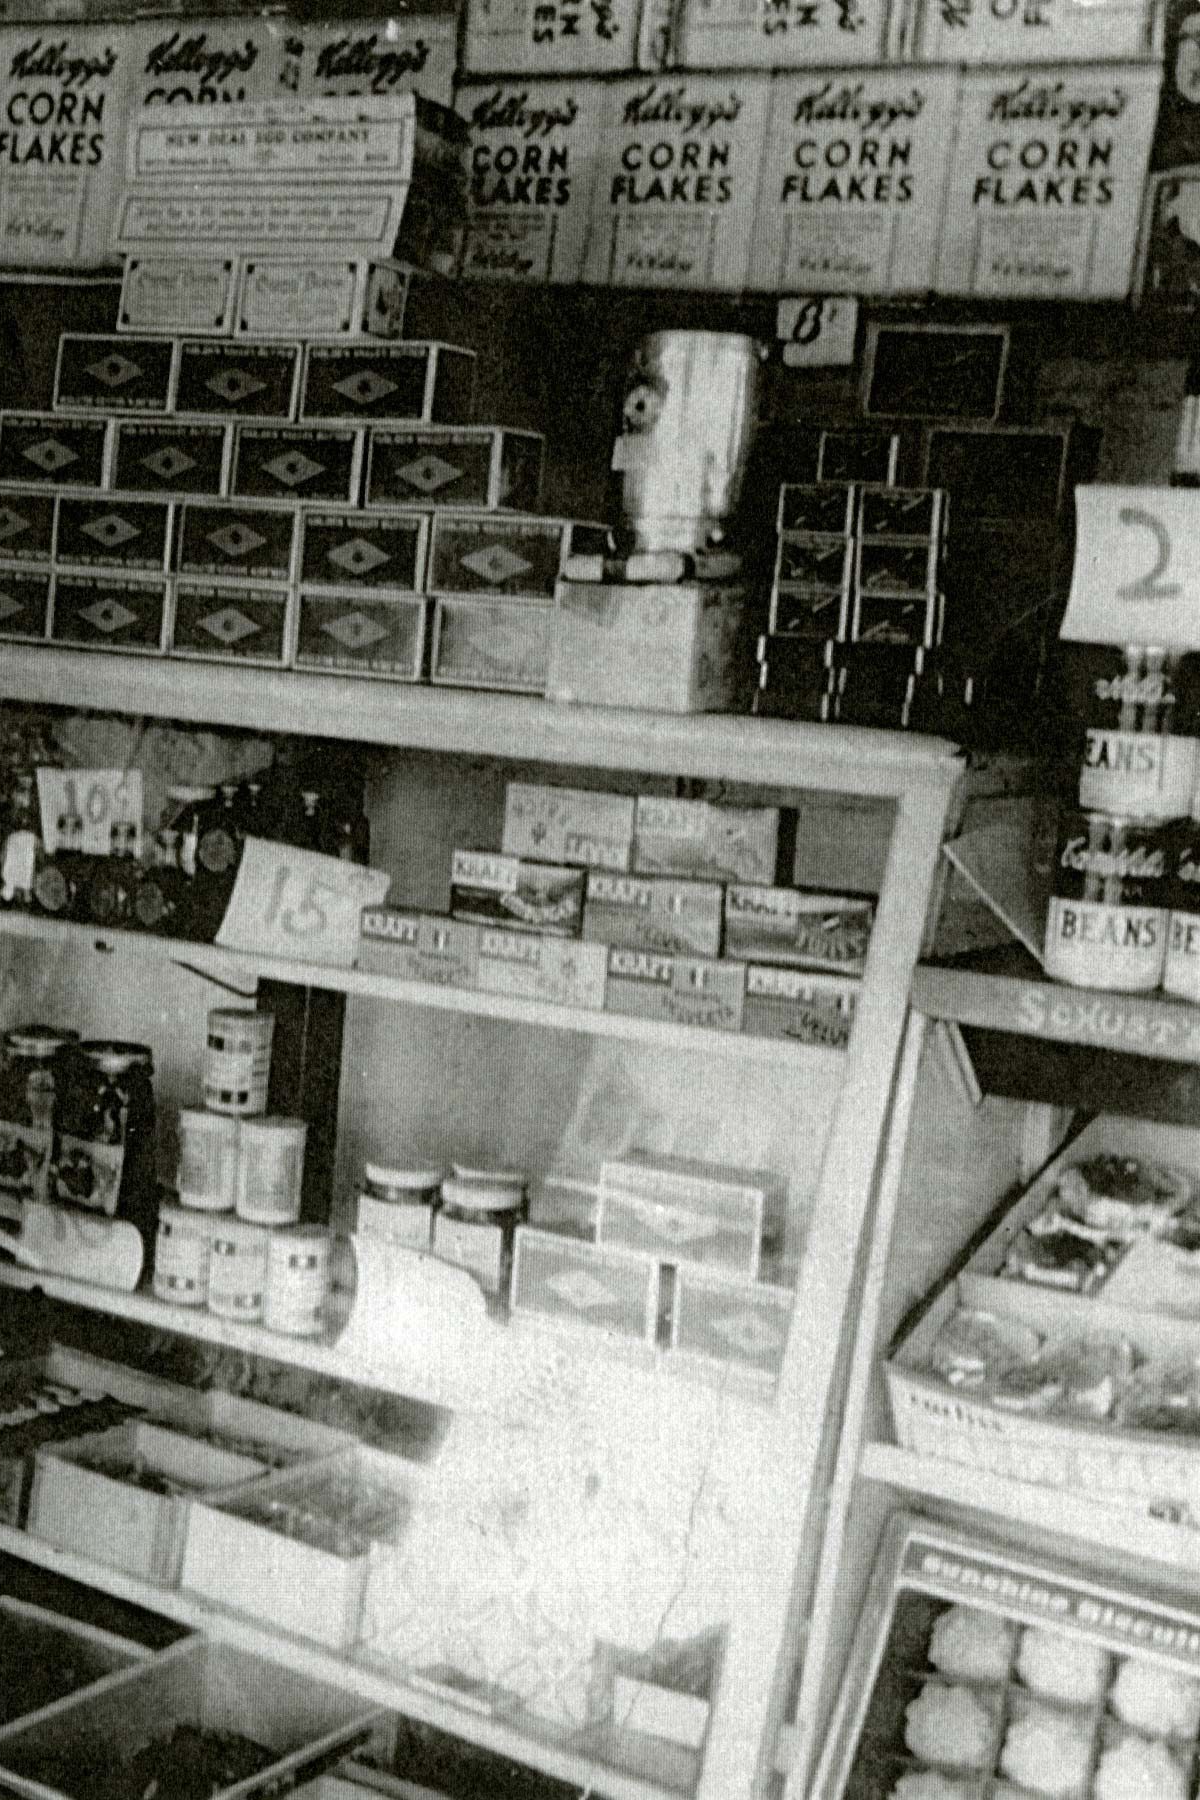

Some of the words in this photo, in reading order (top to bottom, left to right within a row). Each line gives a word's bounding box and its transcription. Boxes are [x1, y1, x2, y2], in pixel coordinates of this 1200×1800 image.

[10, 37, 117, 87] Kellogg's
[144, 32, 260, 84] Kellogg's
[314, 36, 430, 91] Kellogg's
[6, 91, 105, 125] CORN
[622, 84, 741, 133] Kellogg's
[794, 82, 926, 131] Kellogg's
[987, 80, 1127, 131] Kellogg's
[471, 144, 569, 174] CORN
[621, 142, 730, 171] CORN
[795, 140, 912, 169] CORN
[986, 141, 1113, 171] CORN
[471, 176, 572, 206] LAKES
[611, 175, 732, 205] FLAKES
[781, 174, 914, 203] FLAKES
[973, 174, 1114, 206] FLAKES
[1086, 737, 1153, 771] EANS
[1061, 909, 1157, 949] BEANS
[922, 1553, 1069, 1611] Sunshine
